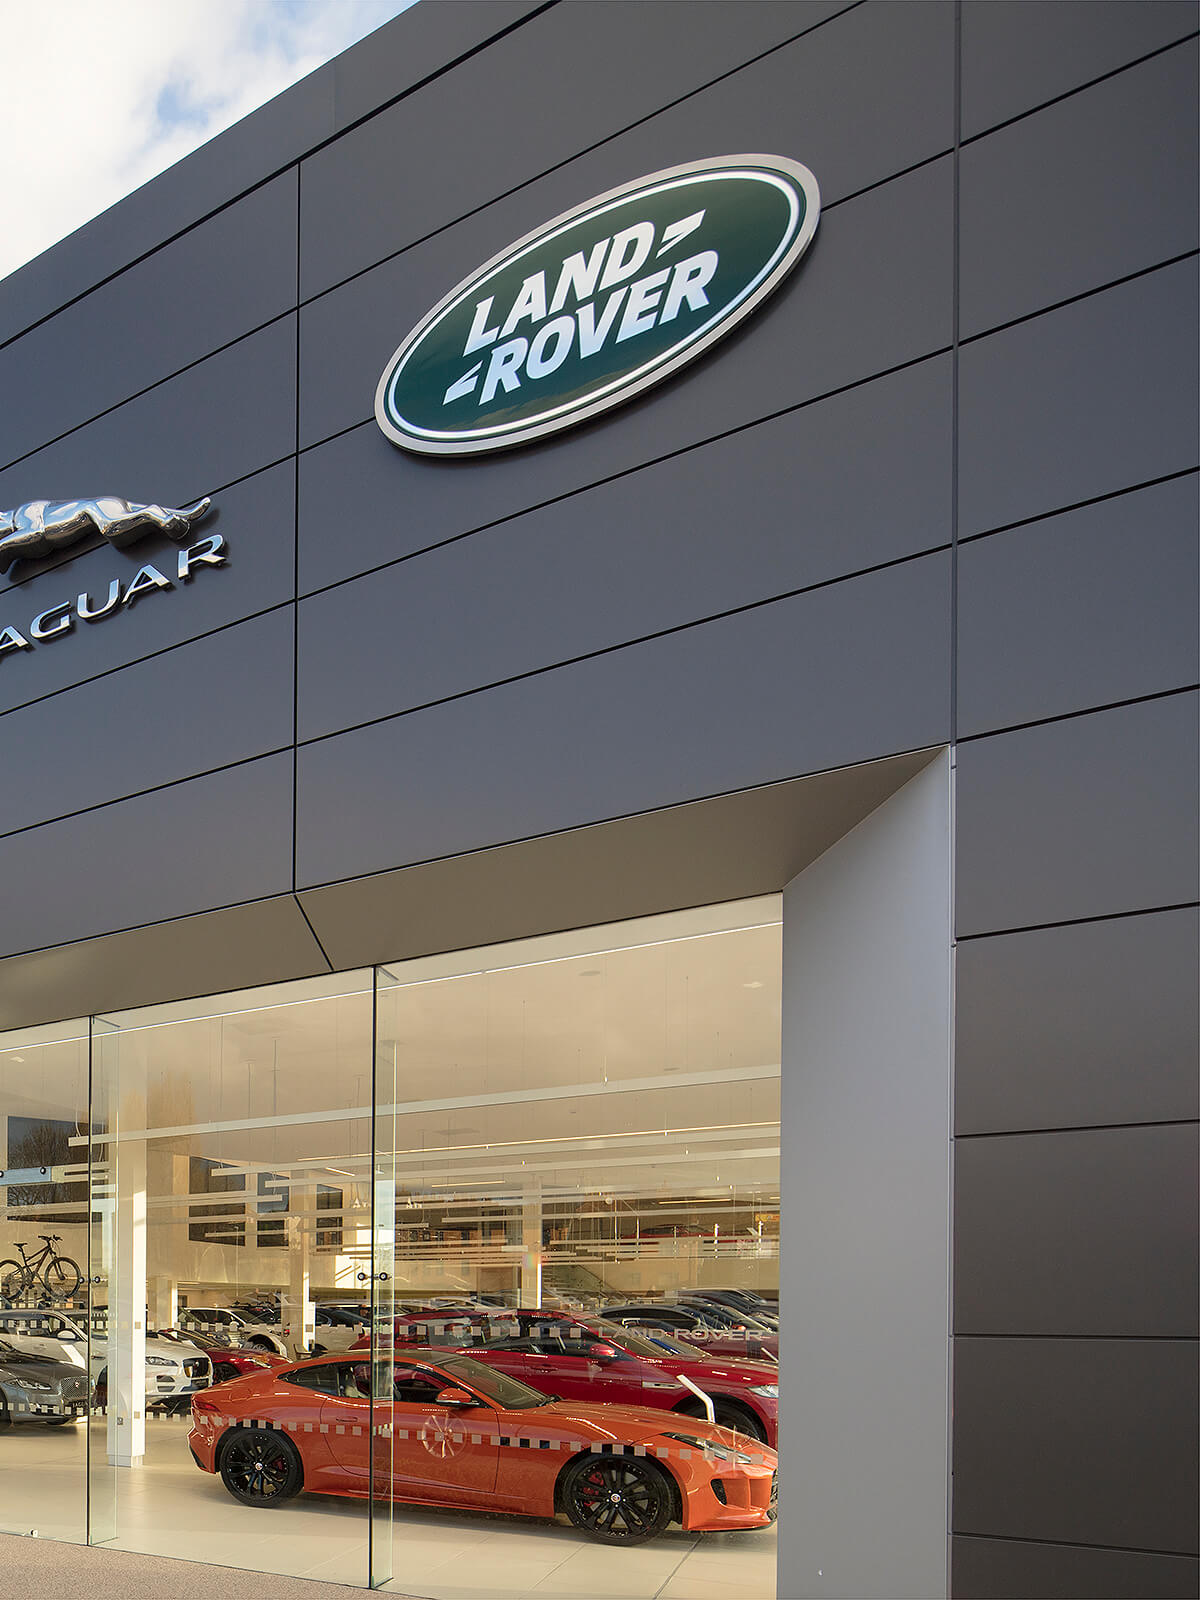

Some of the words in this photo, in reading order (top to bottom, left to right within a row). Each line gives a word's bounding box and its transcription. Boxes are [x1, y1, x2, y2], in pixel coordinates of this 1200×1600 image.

[462, 220, 656, 357] LAND
[478, 249, 719, 406] ROVER
[598, 1328, 666, 1340] LAND
[674, 1328, 763, 1342] ROVER
